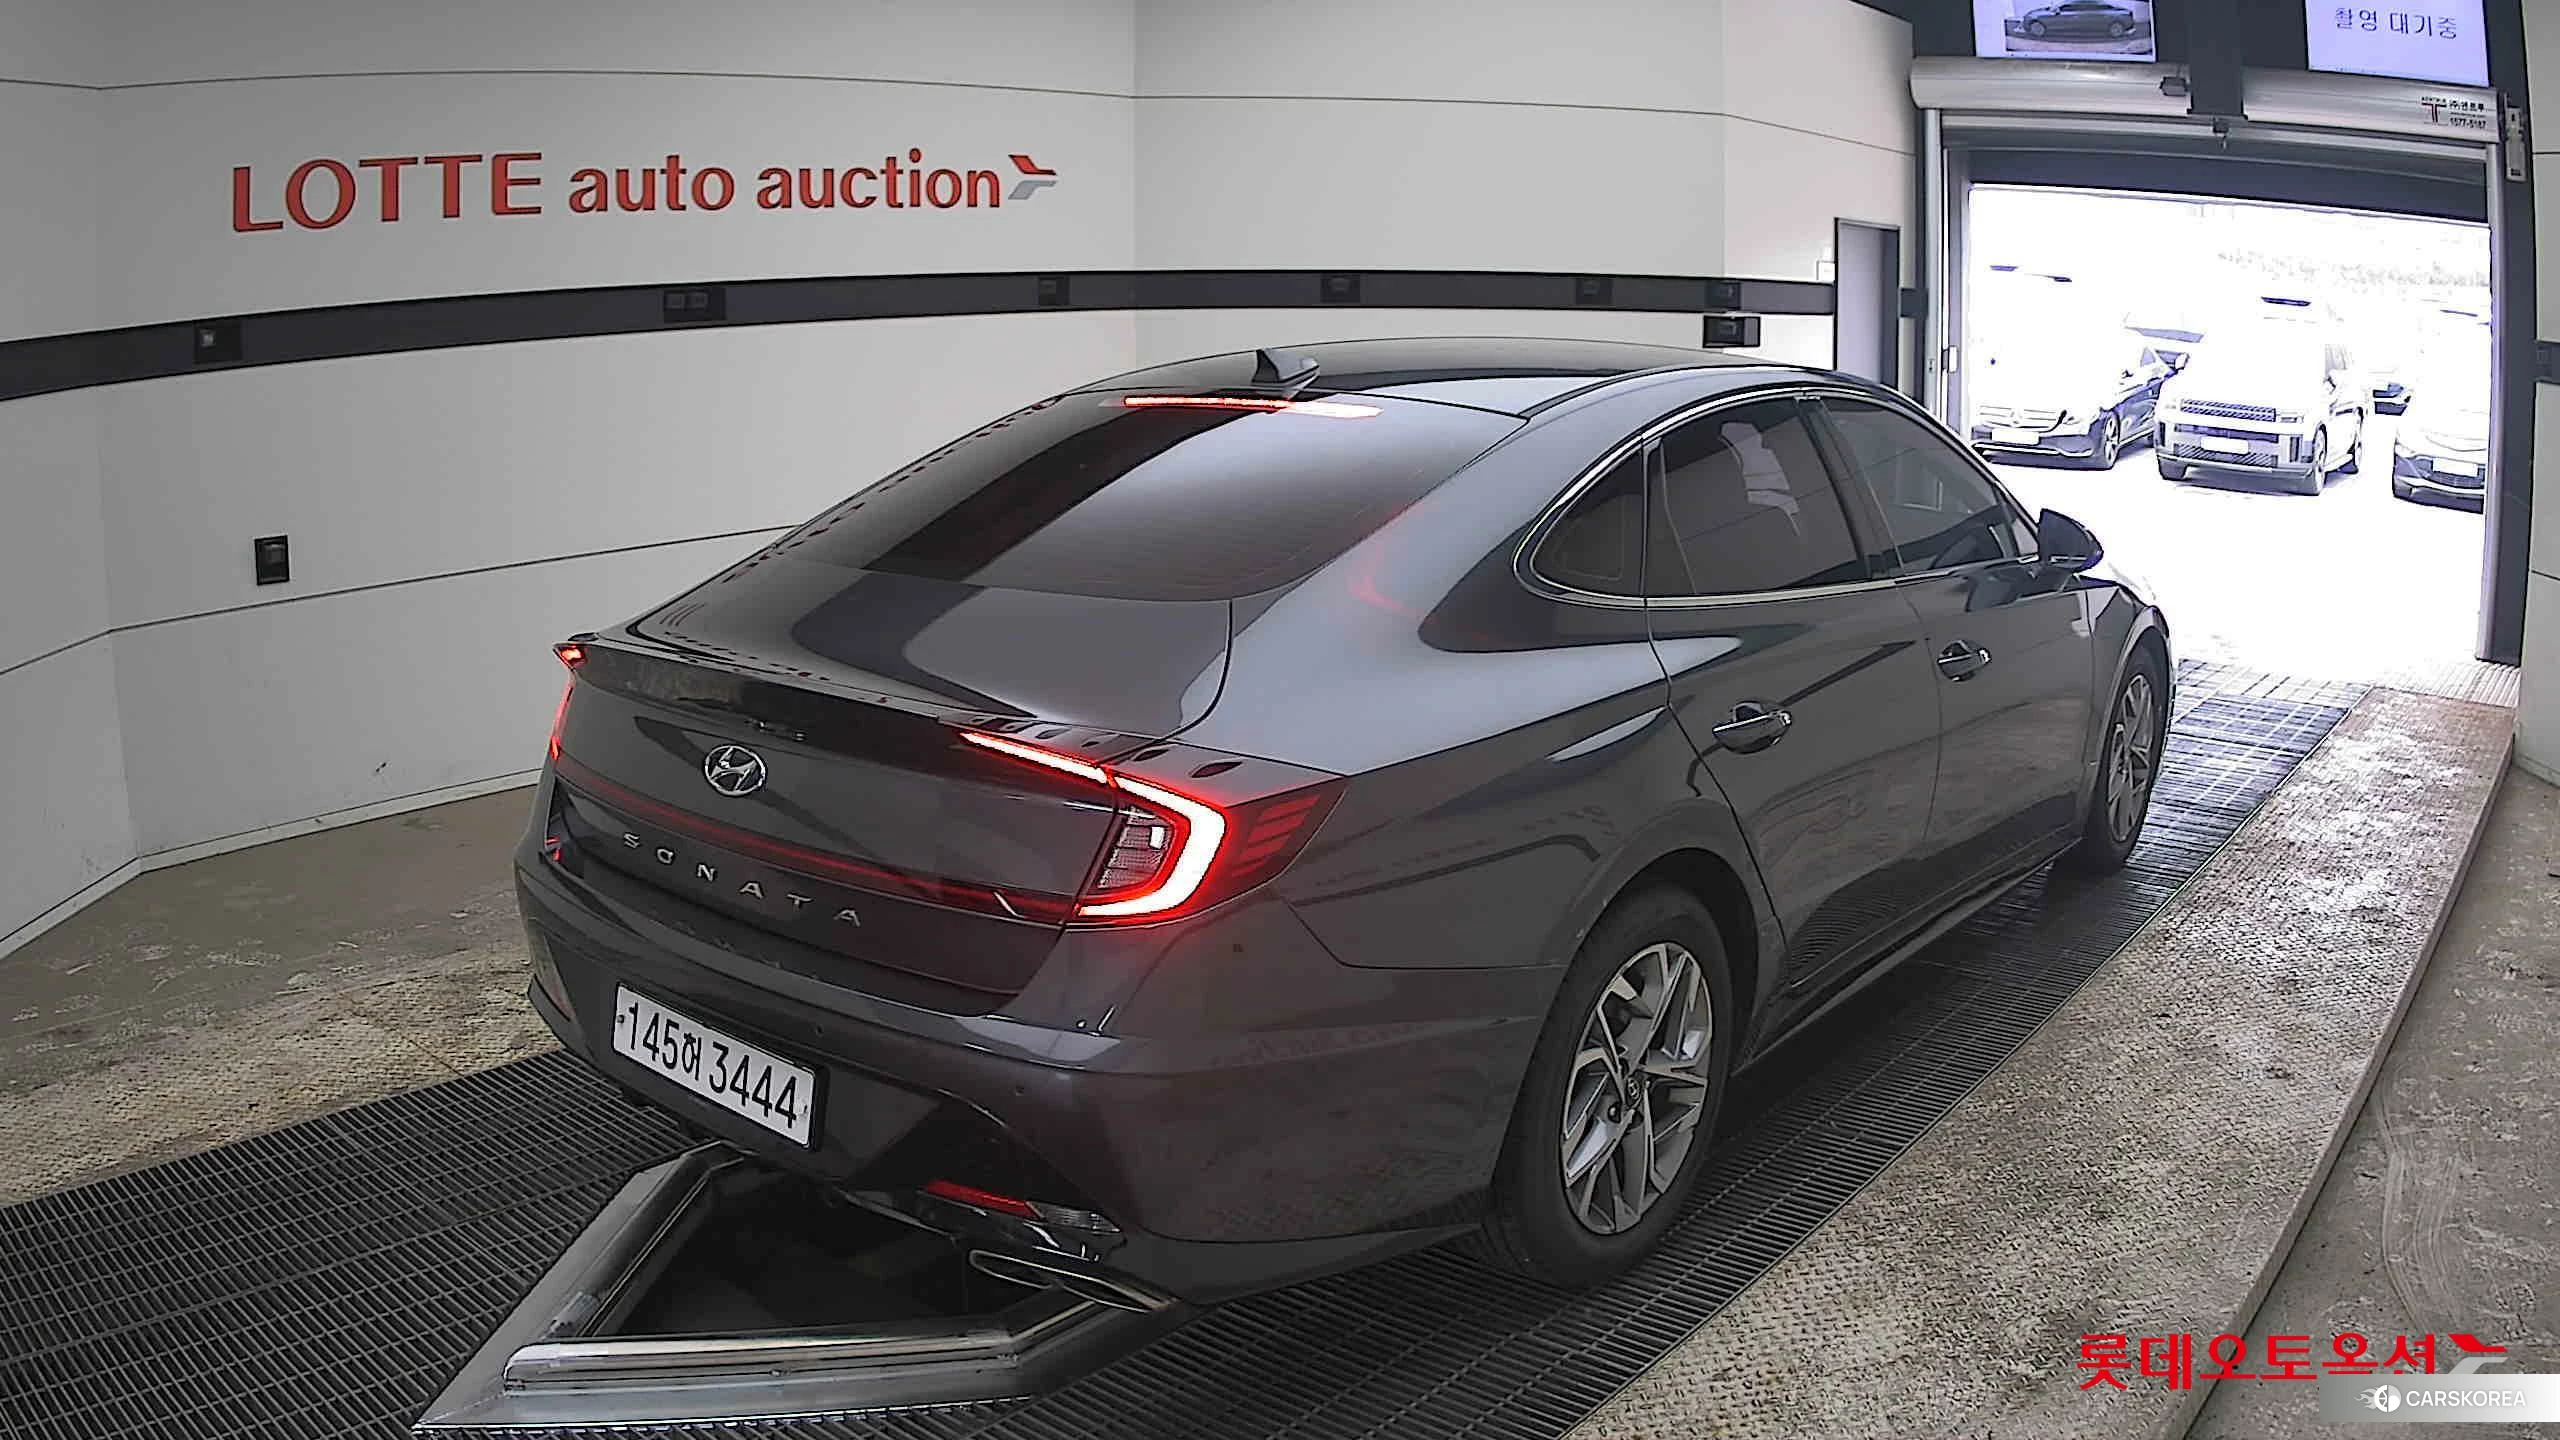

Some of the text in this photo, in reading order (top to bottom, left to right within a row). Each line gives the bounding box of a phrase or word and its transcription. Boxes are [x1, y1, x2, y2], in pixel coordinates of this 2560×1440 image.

[2335, 7, 2457, 40] 촬영 대기중
[232, 147, 1001, 233] LOTTE auto auction
[622, 832, 861, 928] SONATA
[628, 1001, 798, 1129] 145허 3444
